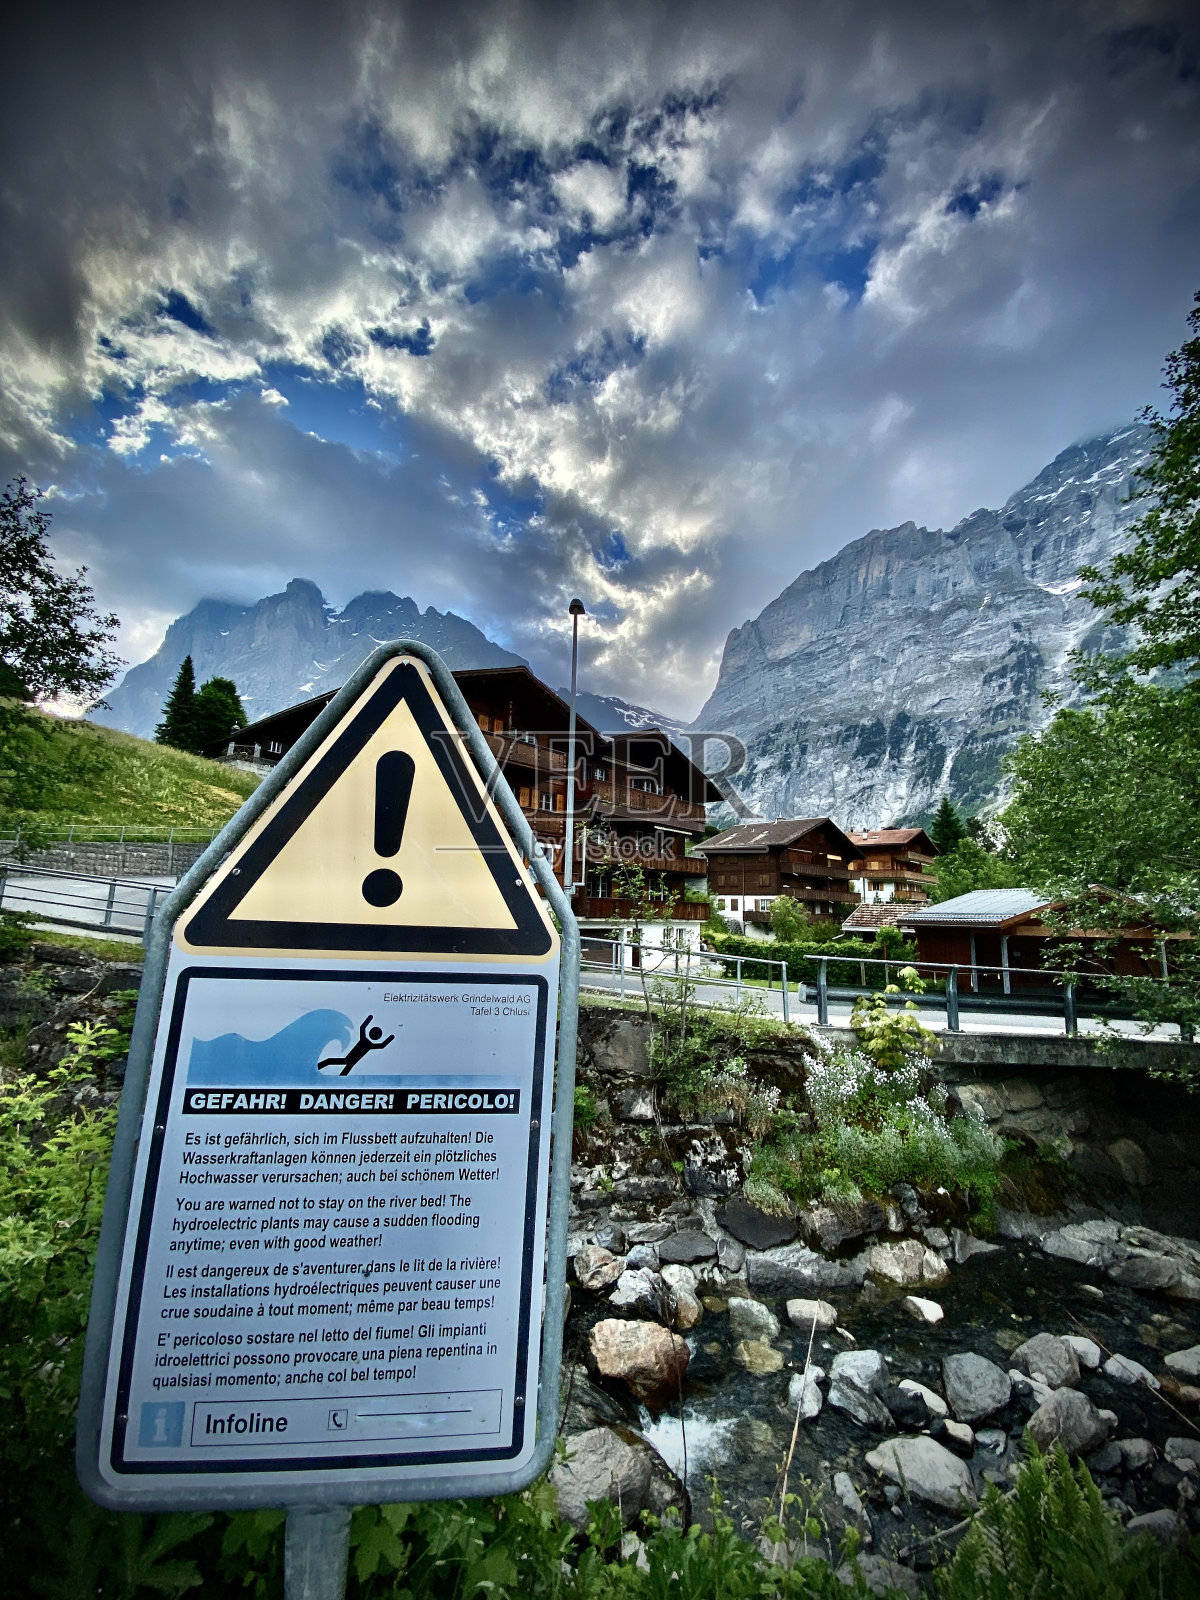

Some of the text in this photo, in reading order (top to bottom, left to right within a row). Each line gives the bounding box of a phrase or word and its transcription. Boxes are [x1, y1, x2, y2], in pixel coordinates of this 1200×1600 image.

[383, 992, 531, 1004] Elektrizitätswerk Grindelwald AG
[470, 1005, 492, 1016] Tafel
[494, 1006, 500, 1016] 3
[190, 1093, 514, 1109] GEFAHR! DANGER! PERICOLO!
[185, 1131, 494, 1148] Es ist gefährlich, sich im Flussbett aufzuhalten! Die
[183, 1150, 497, 1167] Wasserkraftanlagen können jederzeit ein plötzliches
[179, 1168, 499, 1184] Hochwasser verursachen; auch bei schönem Wetter!
[176, 1194, 471, 1212] You are warned not to stay on the river bed! The
[172, 1213, 480, 1234] hydroelectric plants may cause a sudden flooding
[169, 1234, 382, 1255] anytime; even with good weather!
[166, 1265, 174, 1279] Il
[177, 1266, 198, 1279] est
[201, 1264, 269, 1281] dangereux
[273, 1262, 289, 1276] de
[366, 1260, 396, 1274] dans
[399, 1259, 410, 1272] le
[413, 1259, 425, 1272] lit
[428, 1258, 443, 1271] de
[446, 1258, 456, 1271] la
[460, 1256, 500, 1270] rivière!
[163, 1278, 501, 1299] Les installations hydroélectriques peuvent causer une
[161, 1295, 494, 1319] crue soudaine à tout moment; même par beau temps!
[157, 1322, 486, 1350] E' pericoloso sostare nel letto del fiume! Gli impianti
[155, 1342, 497, 1369] idroelettrici possono provocare una piena repentina in
[152, 1365, 416, 1391] qualsiasi momento; anche col bel tempo!
[205, 1412, 288, 1434] Infoline
